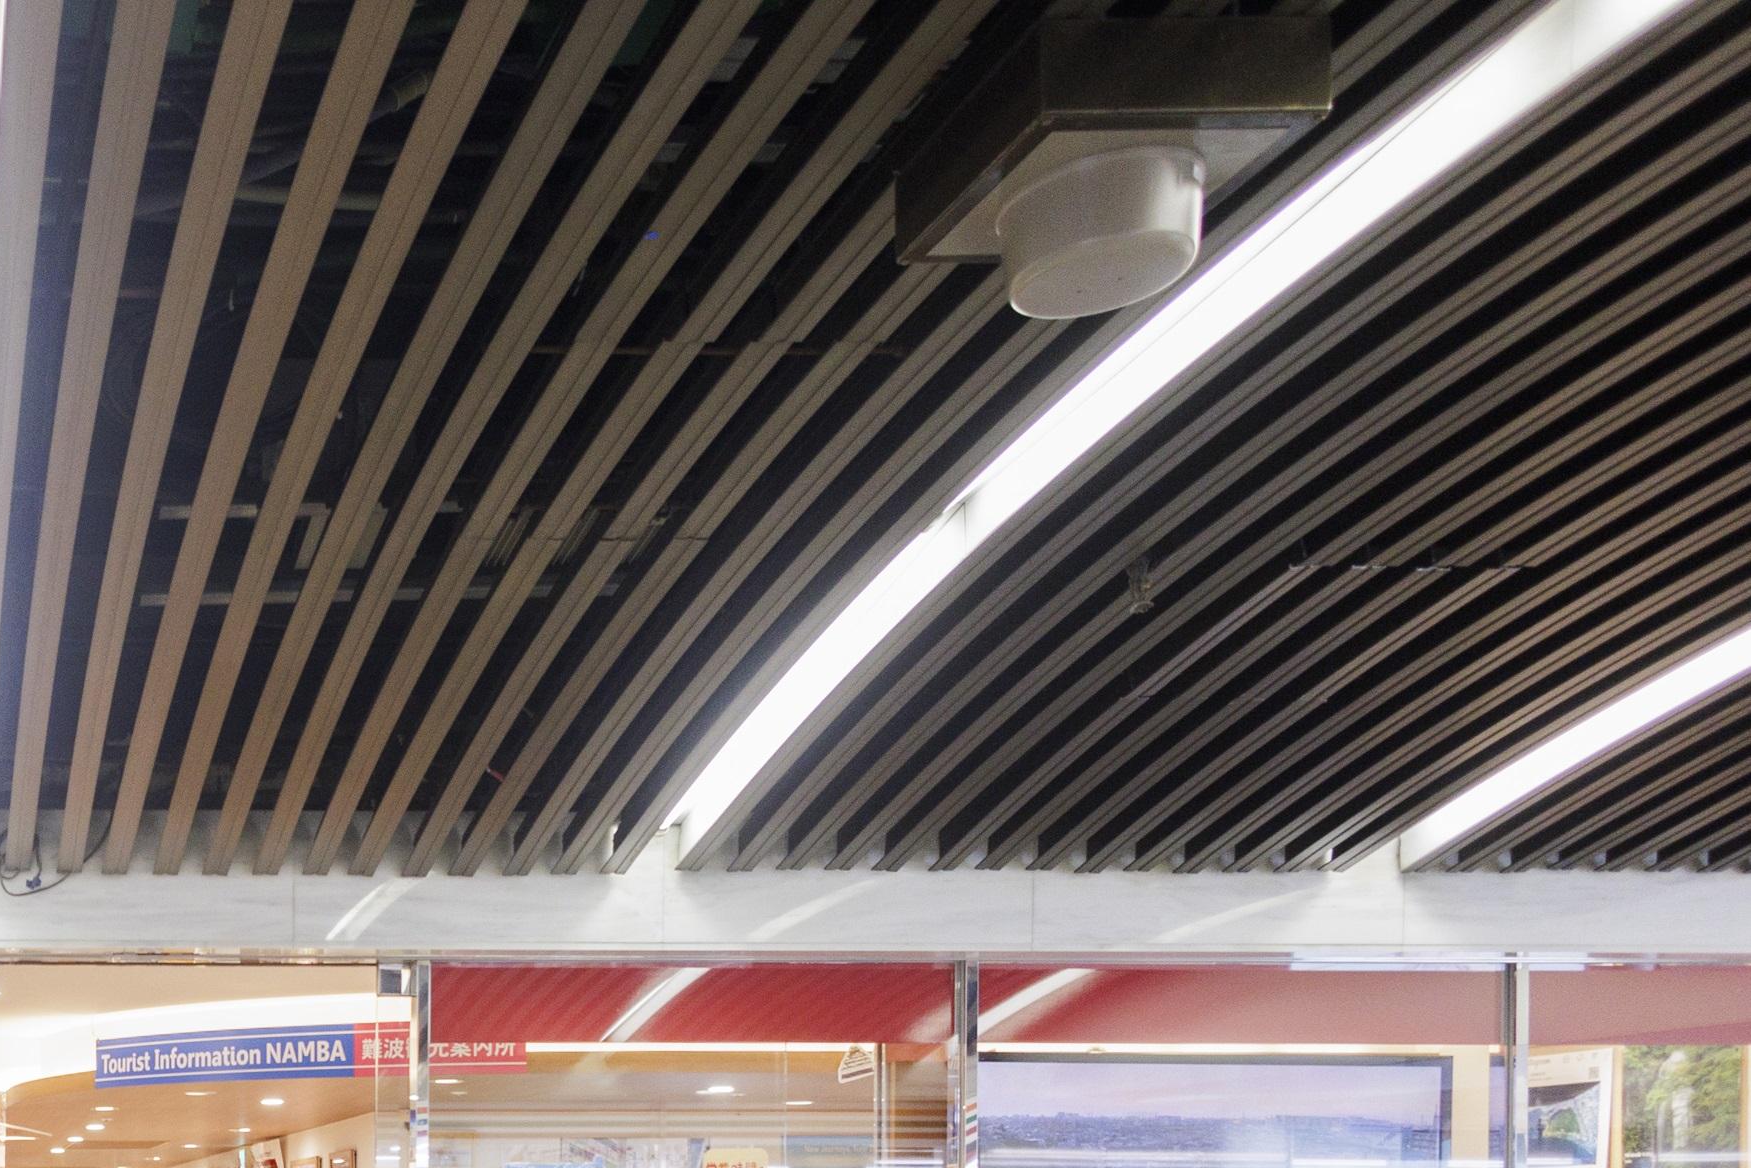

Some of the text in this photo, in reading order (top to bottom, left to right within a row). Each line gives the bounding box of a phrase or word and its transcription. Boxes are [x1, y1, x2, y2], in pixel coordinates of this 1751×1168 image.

[101, 1039, 347, 1075] Tourist Information NAMBA
